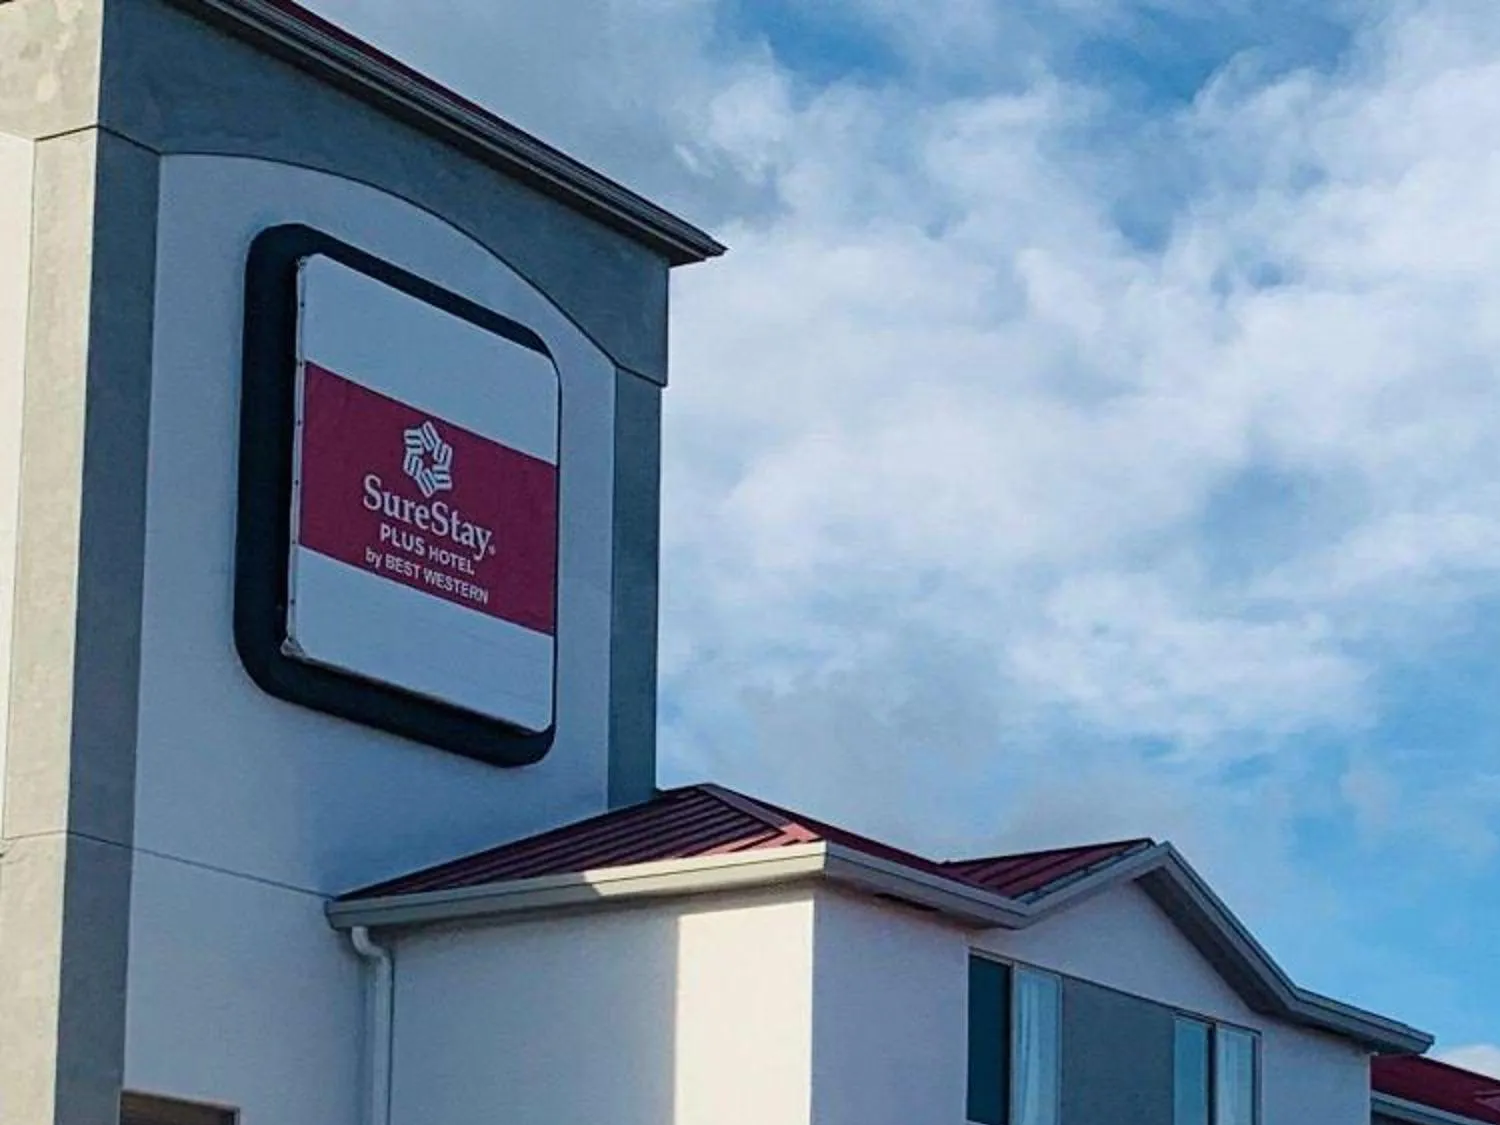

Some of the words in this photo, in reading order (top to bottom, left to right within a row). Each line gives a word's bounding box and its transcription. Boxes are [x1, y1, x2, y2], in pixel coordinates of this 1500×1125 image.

[365, 546, 382, 569] by
[385, 553, 420, 580] BEST
[423, 567, 489, 605] WESTERN
[380, 522, 425, 556] PLUS
[429, 545, 475, 576] HOTEL
